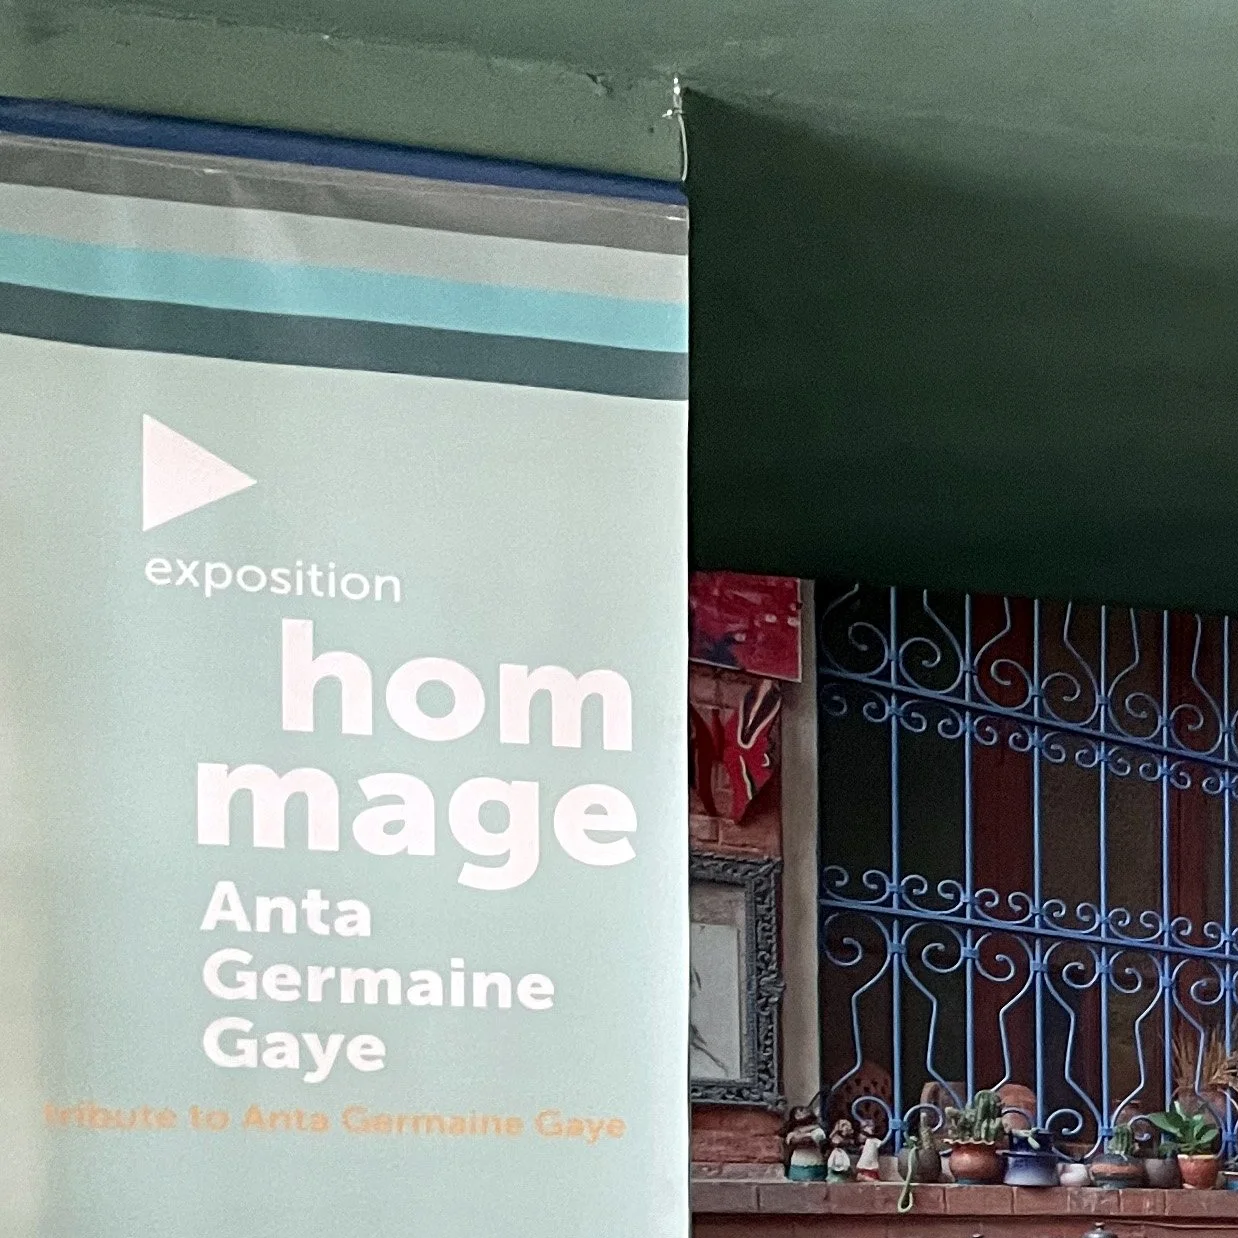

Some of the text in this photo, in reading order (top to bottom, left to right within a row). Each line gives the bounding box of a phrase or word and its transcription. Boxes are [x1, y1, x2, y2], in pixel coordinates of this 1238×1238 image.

[145, 557, 401, 602] exposition
[282, 618, 633, 751] hom
[197, 762, 638, 890] mage
[200, 881, 371, 937] Anta
[203, 948, 555, 1010] Germaine
[203, 1017, 386, 1083] Gaye
[189, 1104, 230, 1130] to
[244, 1104, 330, 1132] Anta
[341, 1105, 524, 1136] Germaine
[534, 1108, 626, 1144] Gaye
